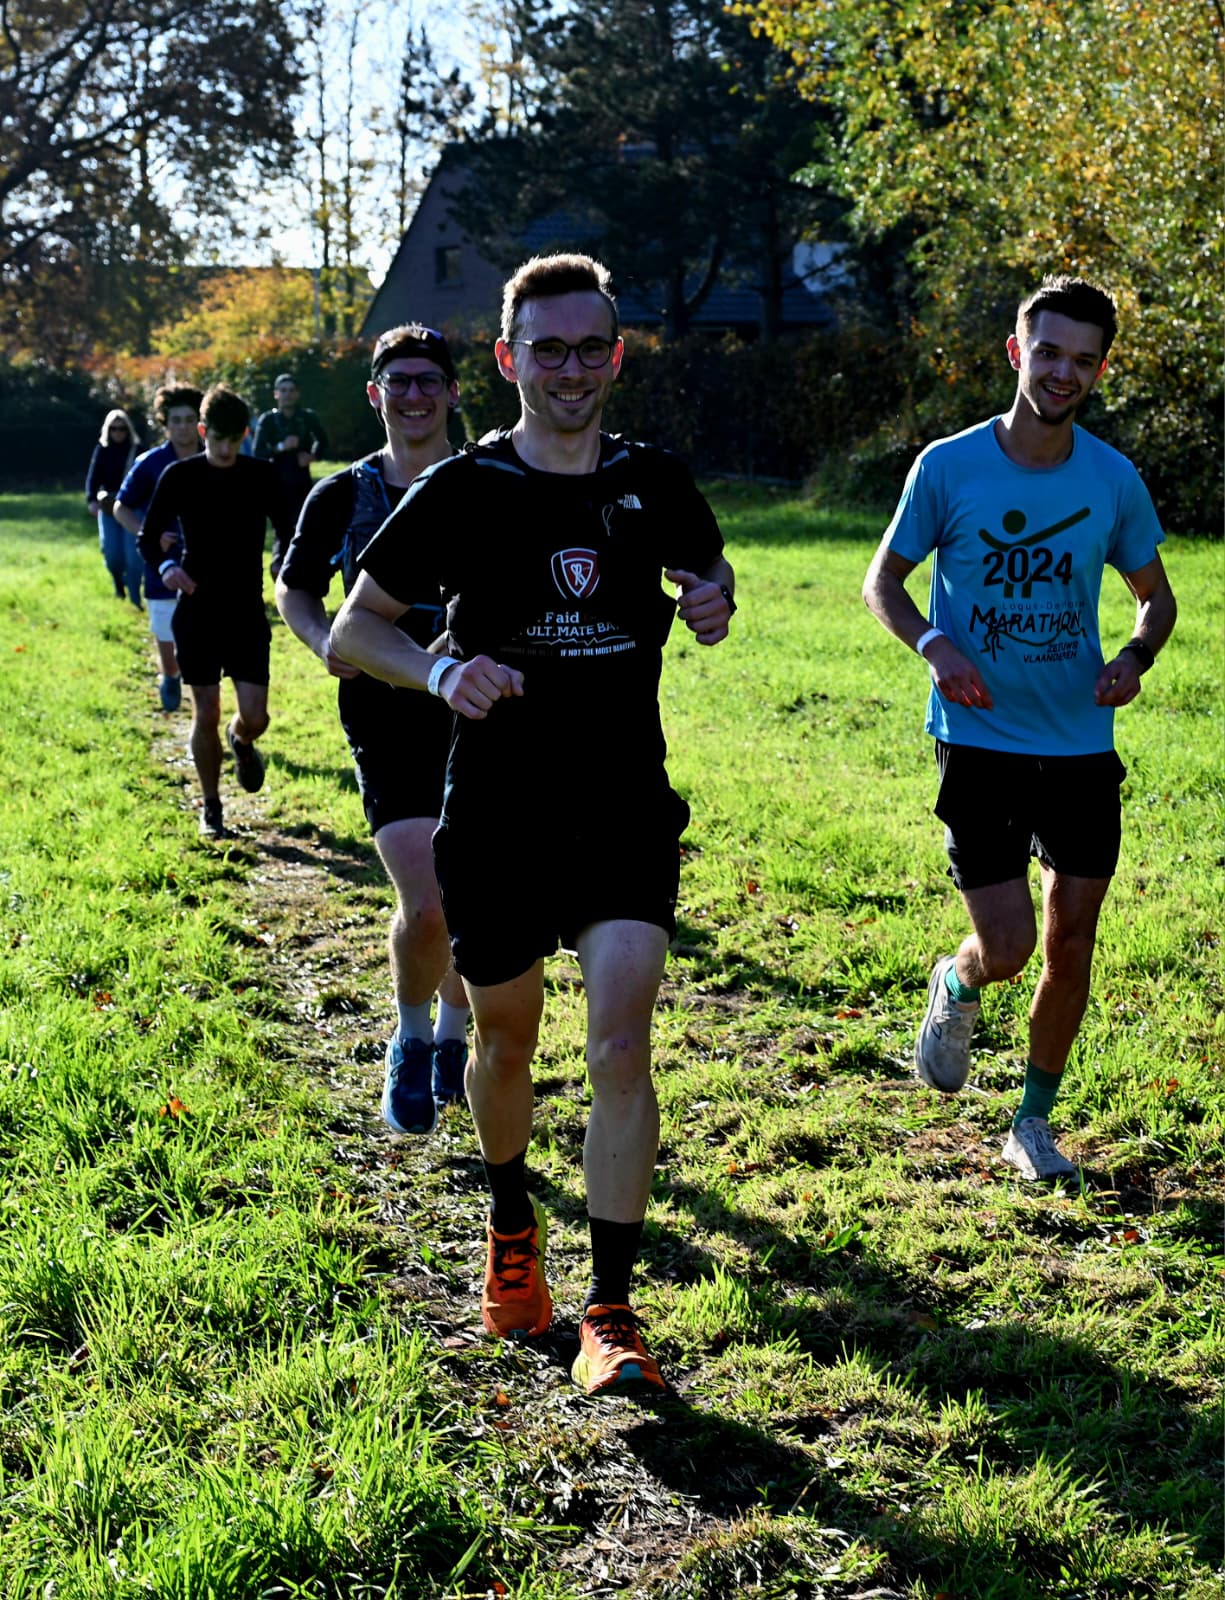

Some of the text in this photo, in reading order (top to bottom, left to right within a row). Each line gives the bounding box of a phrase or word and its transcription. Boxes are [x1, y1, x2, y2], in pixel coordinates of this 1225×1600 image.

[982, 547, 1073, 587] 2024
[968, 603, 1082, 633] MARATHON
[568, 648, 581, 657] NOT
[582, 647, 595, 657] THE
[595, 645, 612, 656] MOST
[1023, 650, 1077, 664] VLAANDEREN
